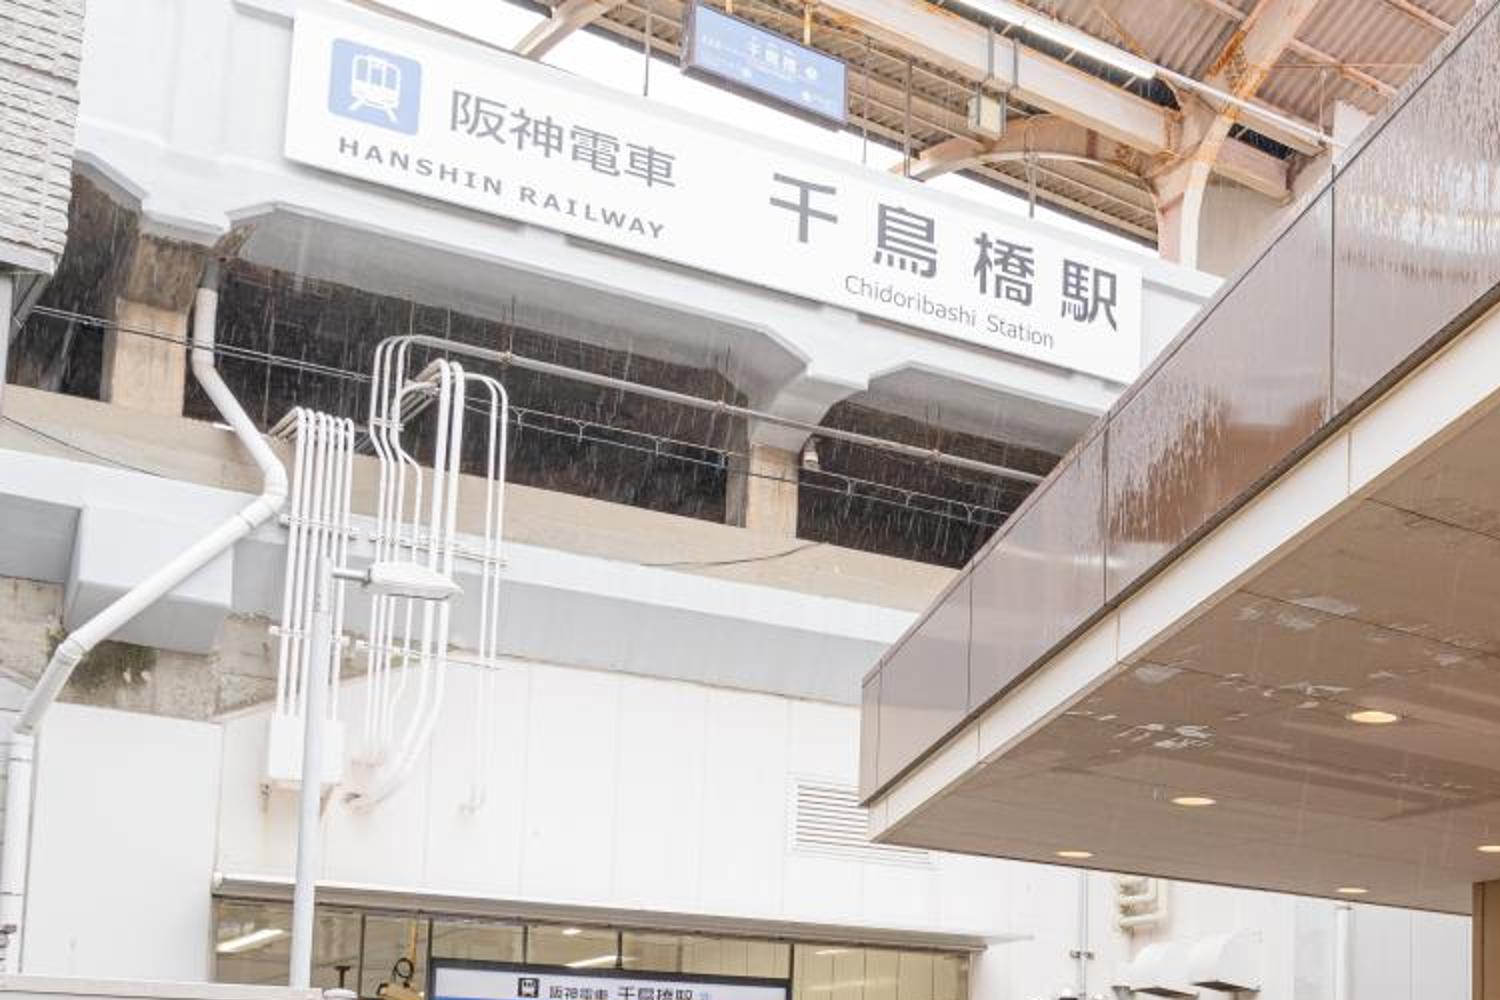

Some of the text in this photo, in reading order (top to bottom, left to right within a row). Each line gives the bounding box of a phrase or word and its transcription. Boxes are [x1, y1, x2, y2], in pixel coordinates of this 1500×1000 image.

[337, 136, 667, 241] HANSHIN RAILWAY
[452, 89, 677, 189] 阪神電車
[770, 172, 1120, 333] 千鳥橋駅
[844, 275, 1056, 350] Chidoribashi Station
